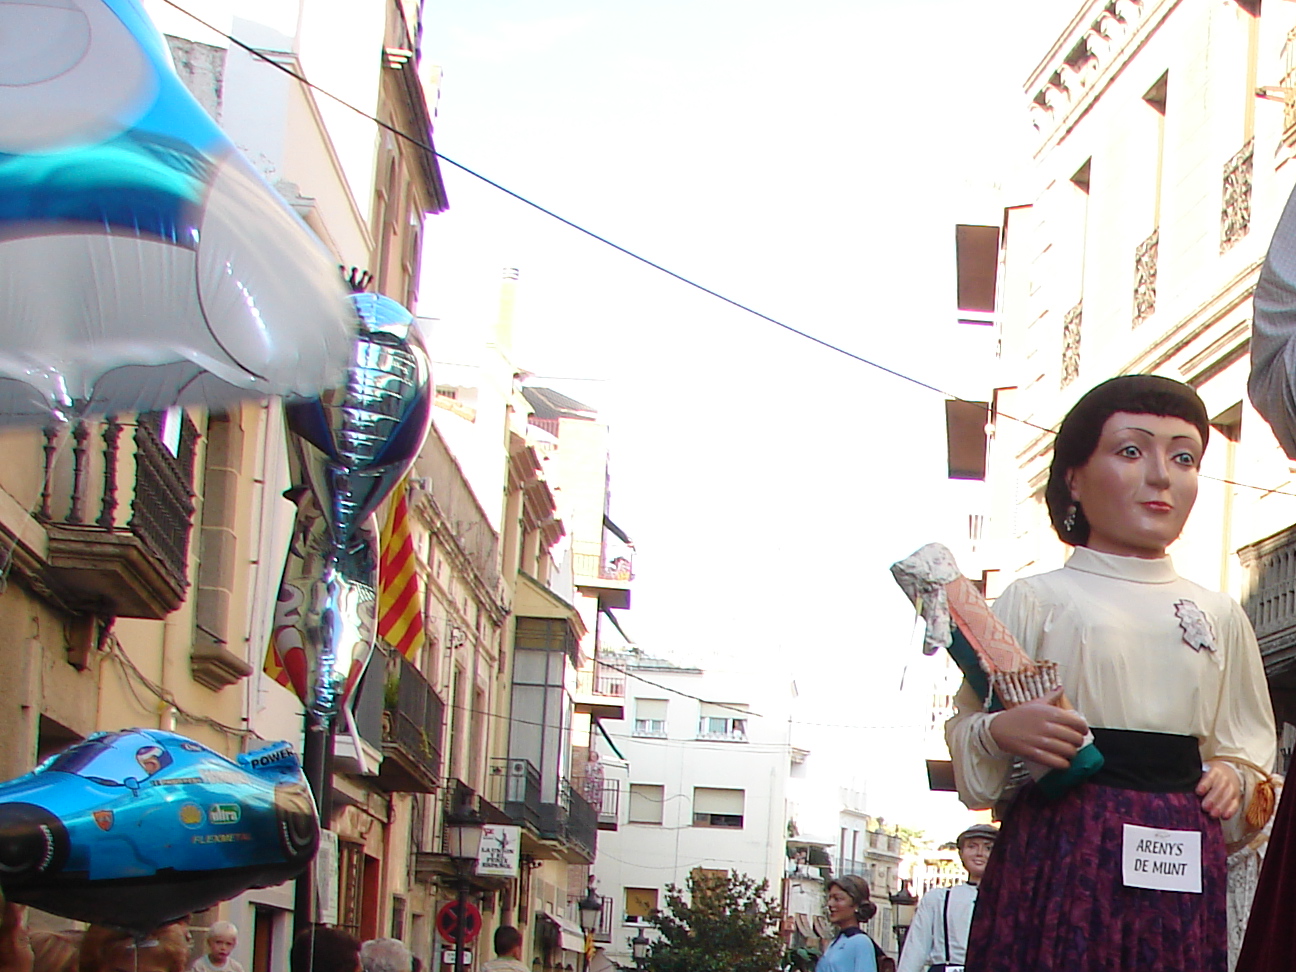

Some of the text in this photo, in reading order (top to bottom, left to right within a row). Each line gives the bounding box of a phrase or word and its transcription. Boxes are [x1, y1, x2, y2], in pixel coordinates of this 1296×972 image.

[251, 749, 294, 769] POWER
[1136, 839, 1184, 856] ARENYS
[1134, 858, 1188, 876] DE MUNT
